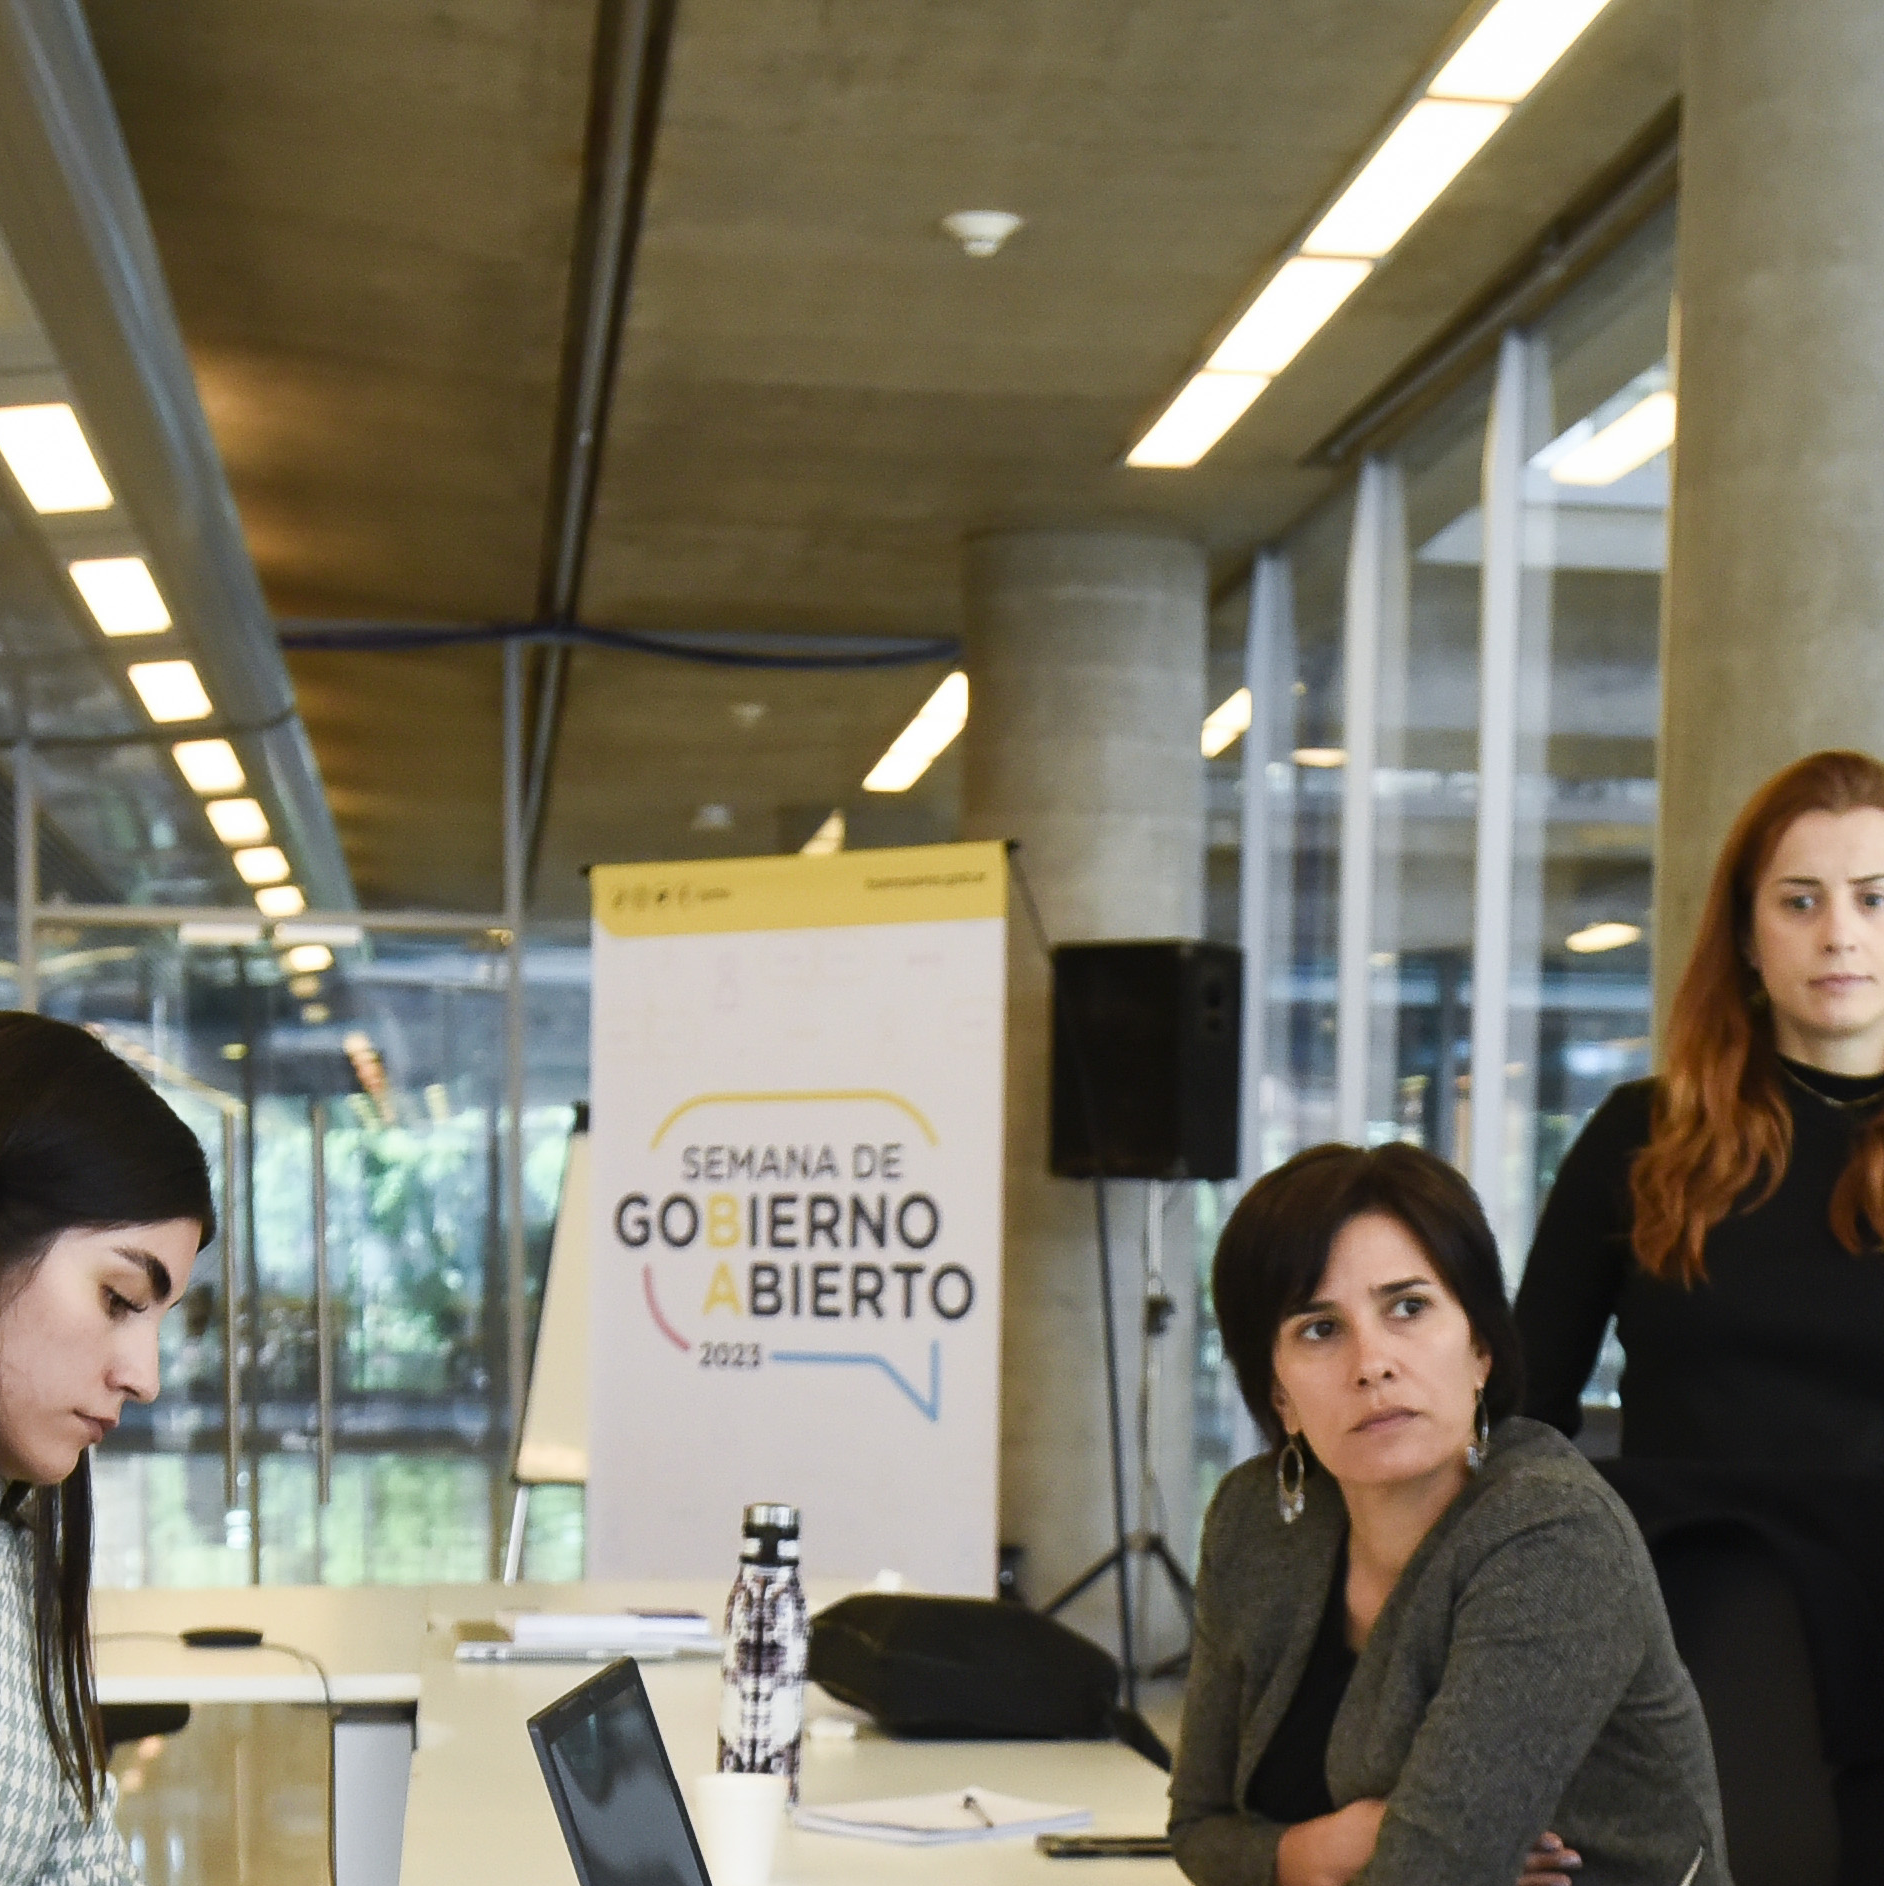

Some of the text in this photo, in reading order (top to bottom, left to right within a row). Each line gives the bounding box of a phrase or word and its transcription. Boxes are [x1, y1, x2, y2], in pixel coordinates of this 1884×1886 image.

[682, 1143, 904, 1181] SEMANA DE
[615, 1190, 940, 1250] GOBIERNO
[703, 1261, 975, 1321] ABIERTO
[699, 1341, 763, 1369] 2023
